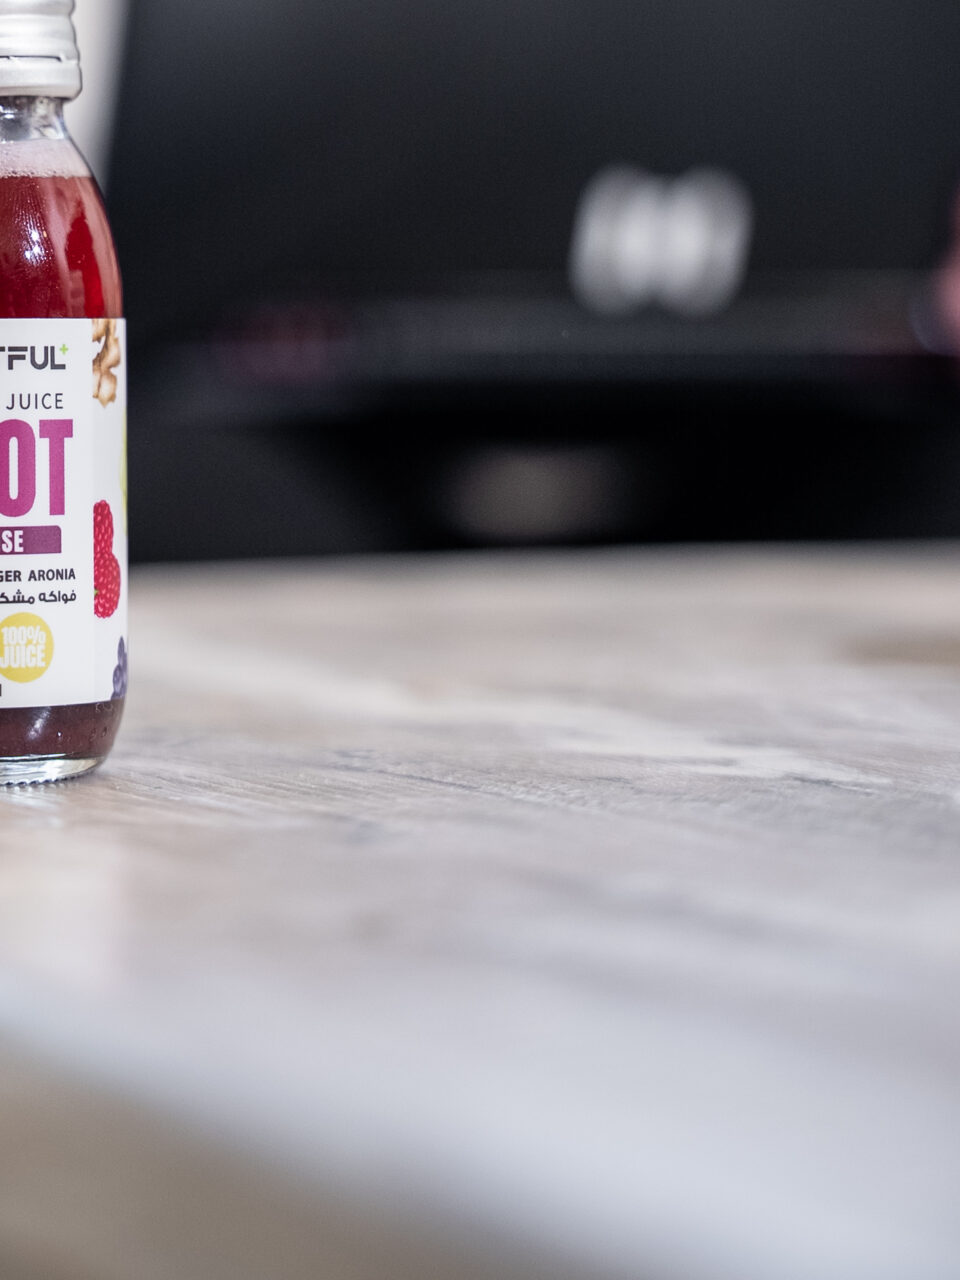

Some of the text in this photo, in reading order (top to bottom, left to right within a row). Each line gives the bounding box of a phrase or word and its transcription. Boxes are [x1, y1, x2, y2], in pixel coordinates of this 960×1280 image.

[6, 392, 64, 410] JUICE
[27, 568, 76, 582] ARONIA
[38, 589, 77, 604] فواكه
[1, 625, 47, 646] 100%
